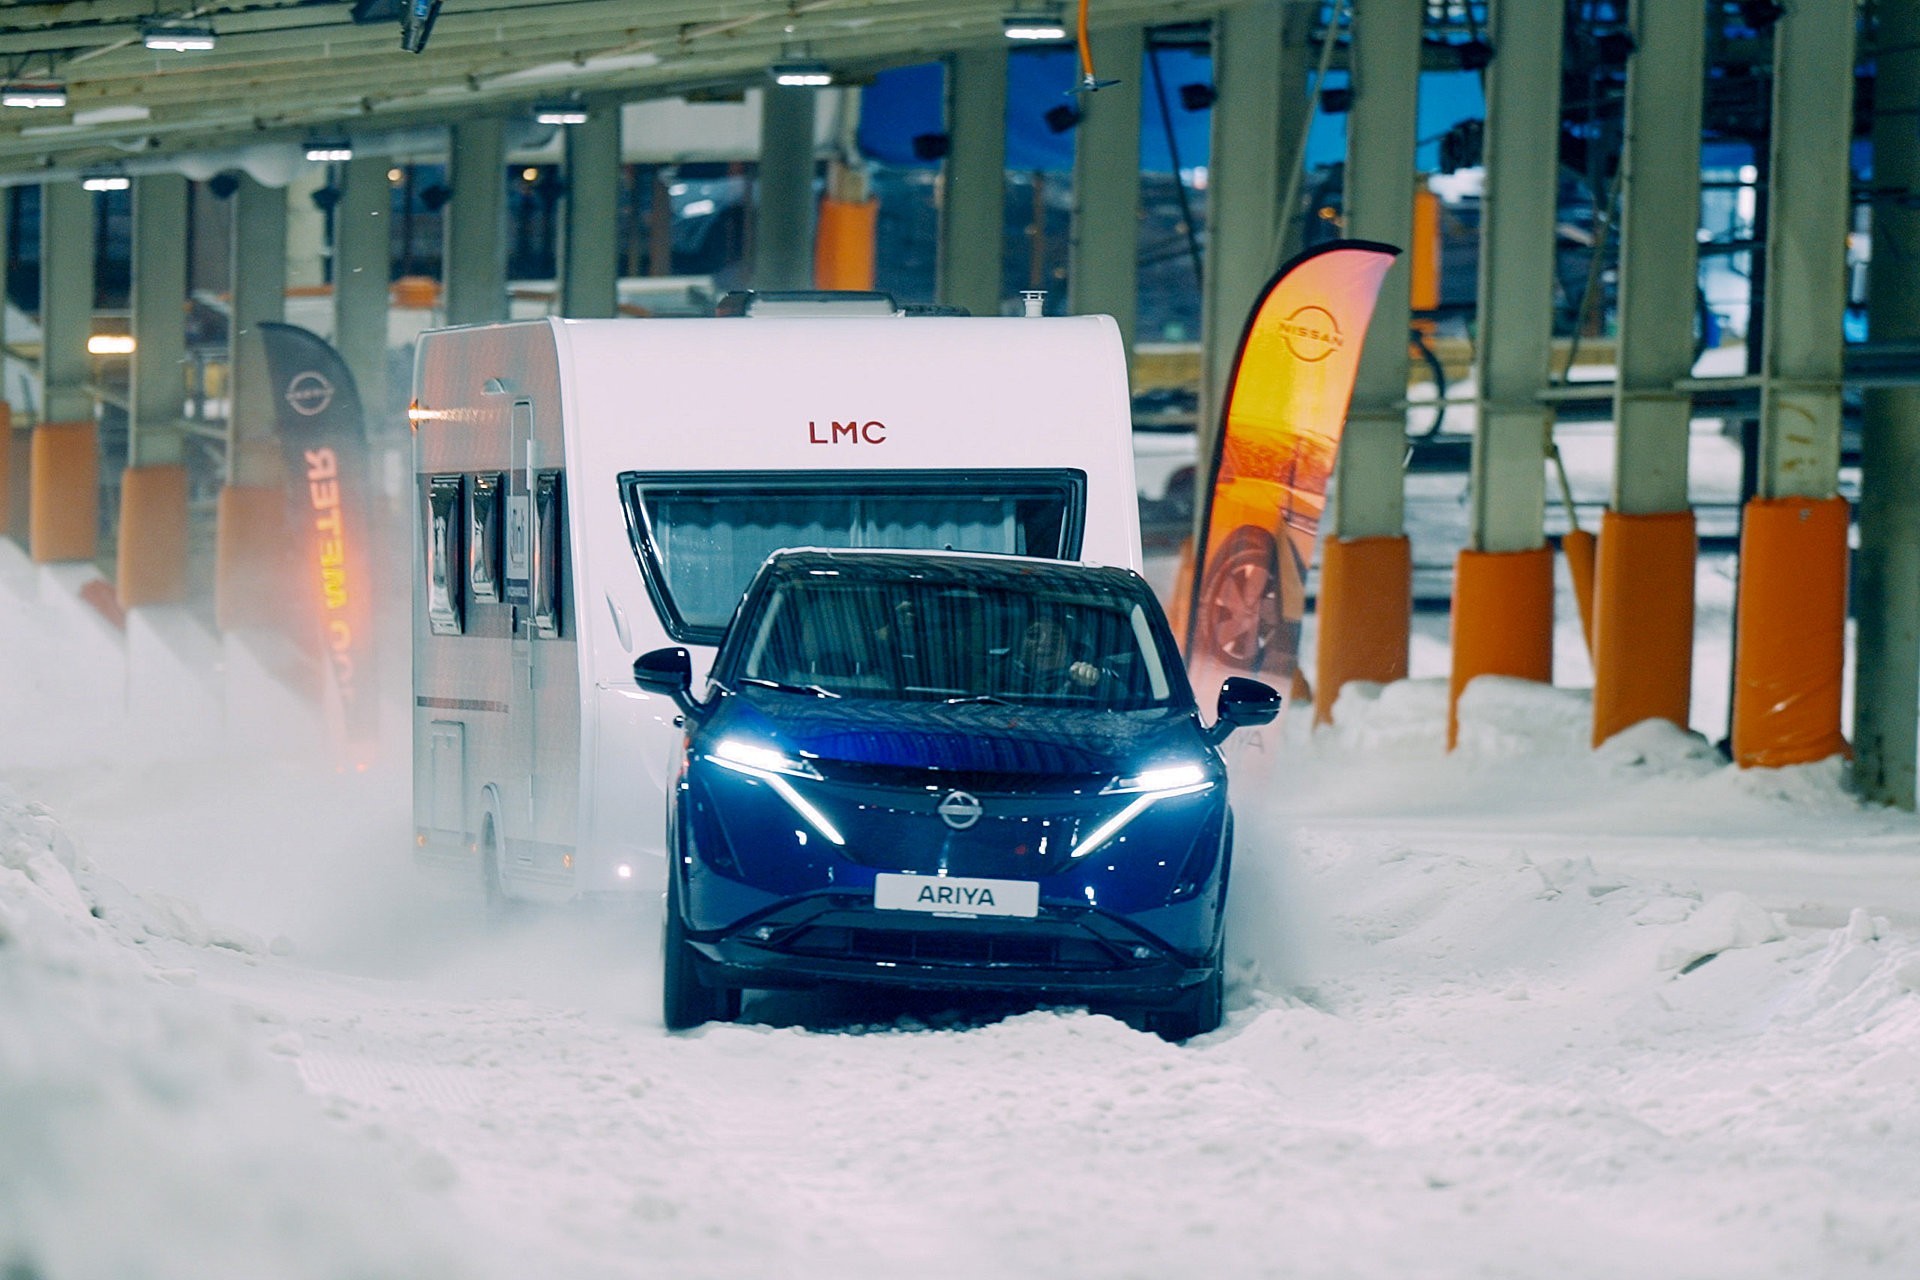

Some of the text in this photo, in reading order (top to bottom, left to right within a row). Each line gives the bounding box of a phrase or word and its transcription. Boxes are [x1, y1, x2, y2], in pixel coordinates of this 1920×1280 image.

[1279, 322, 1343, 347] NISSAN
[809, 421, 886, 444] LMC
[917, 885, 996, 907] ARIYA
